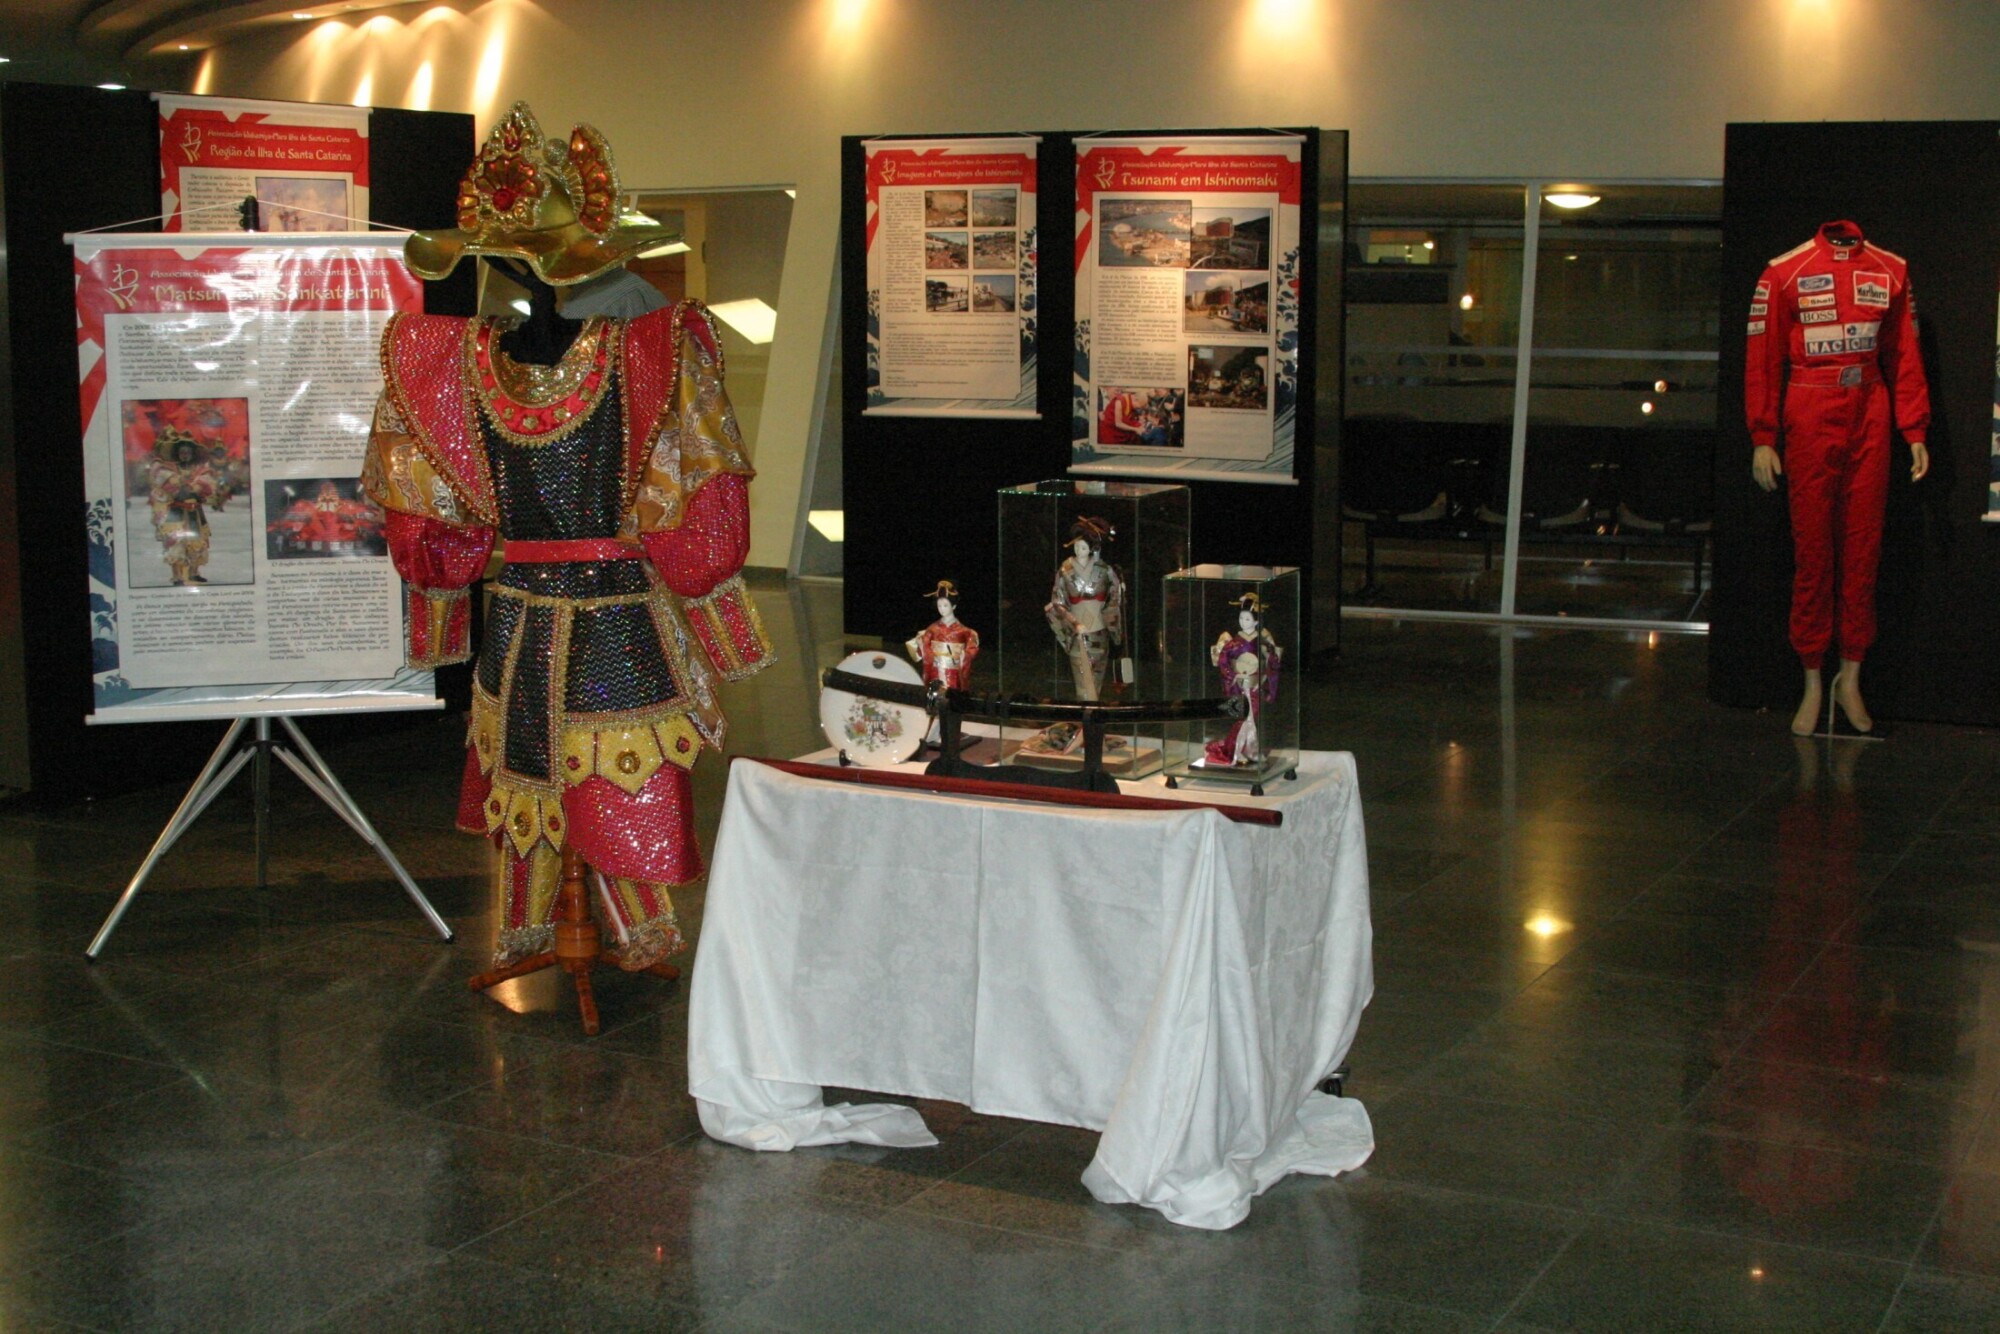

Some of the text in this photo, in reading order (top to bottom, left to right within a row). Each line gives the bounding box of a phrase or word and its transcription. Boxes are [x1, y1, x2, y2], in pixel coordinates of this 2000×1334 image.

[308, 135, 325, 143] Santa
[210, 144, 352, 161] Região da Ilha de Santa Catarina
[896, 171, 926, 181] Imagens
[933, 170, 973, 180] Mensagens
[975, 169, 983, 177] de
[1121, 172, 1279, 187] Tsunami em Ishinomaki
[1857, 285, 1888, 300] Marlboro
[1810, 297, 1834, 306] Shell
[1803, 311, 1835, 322] BOSS
